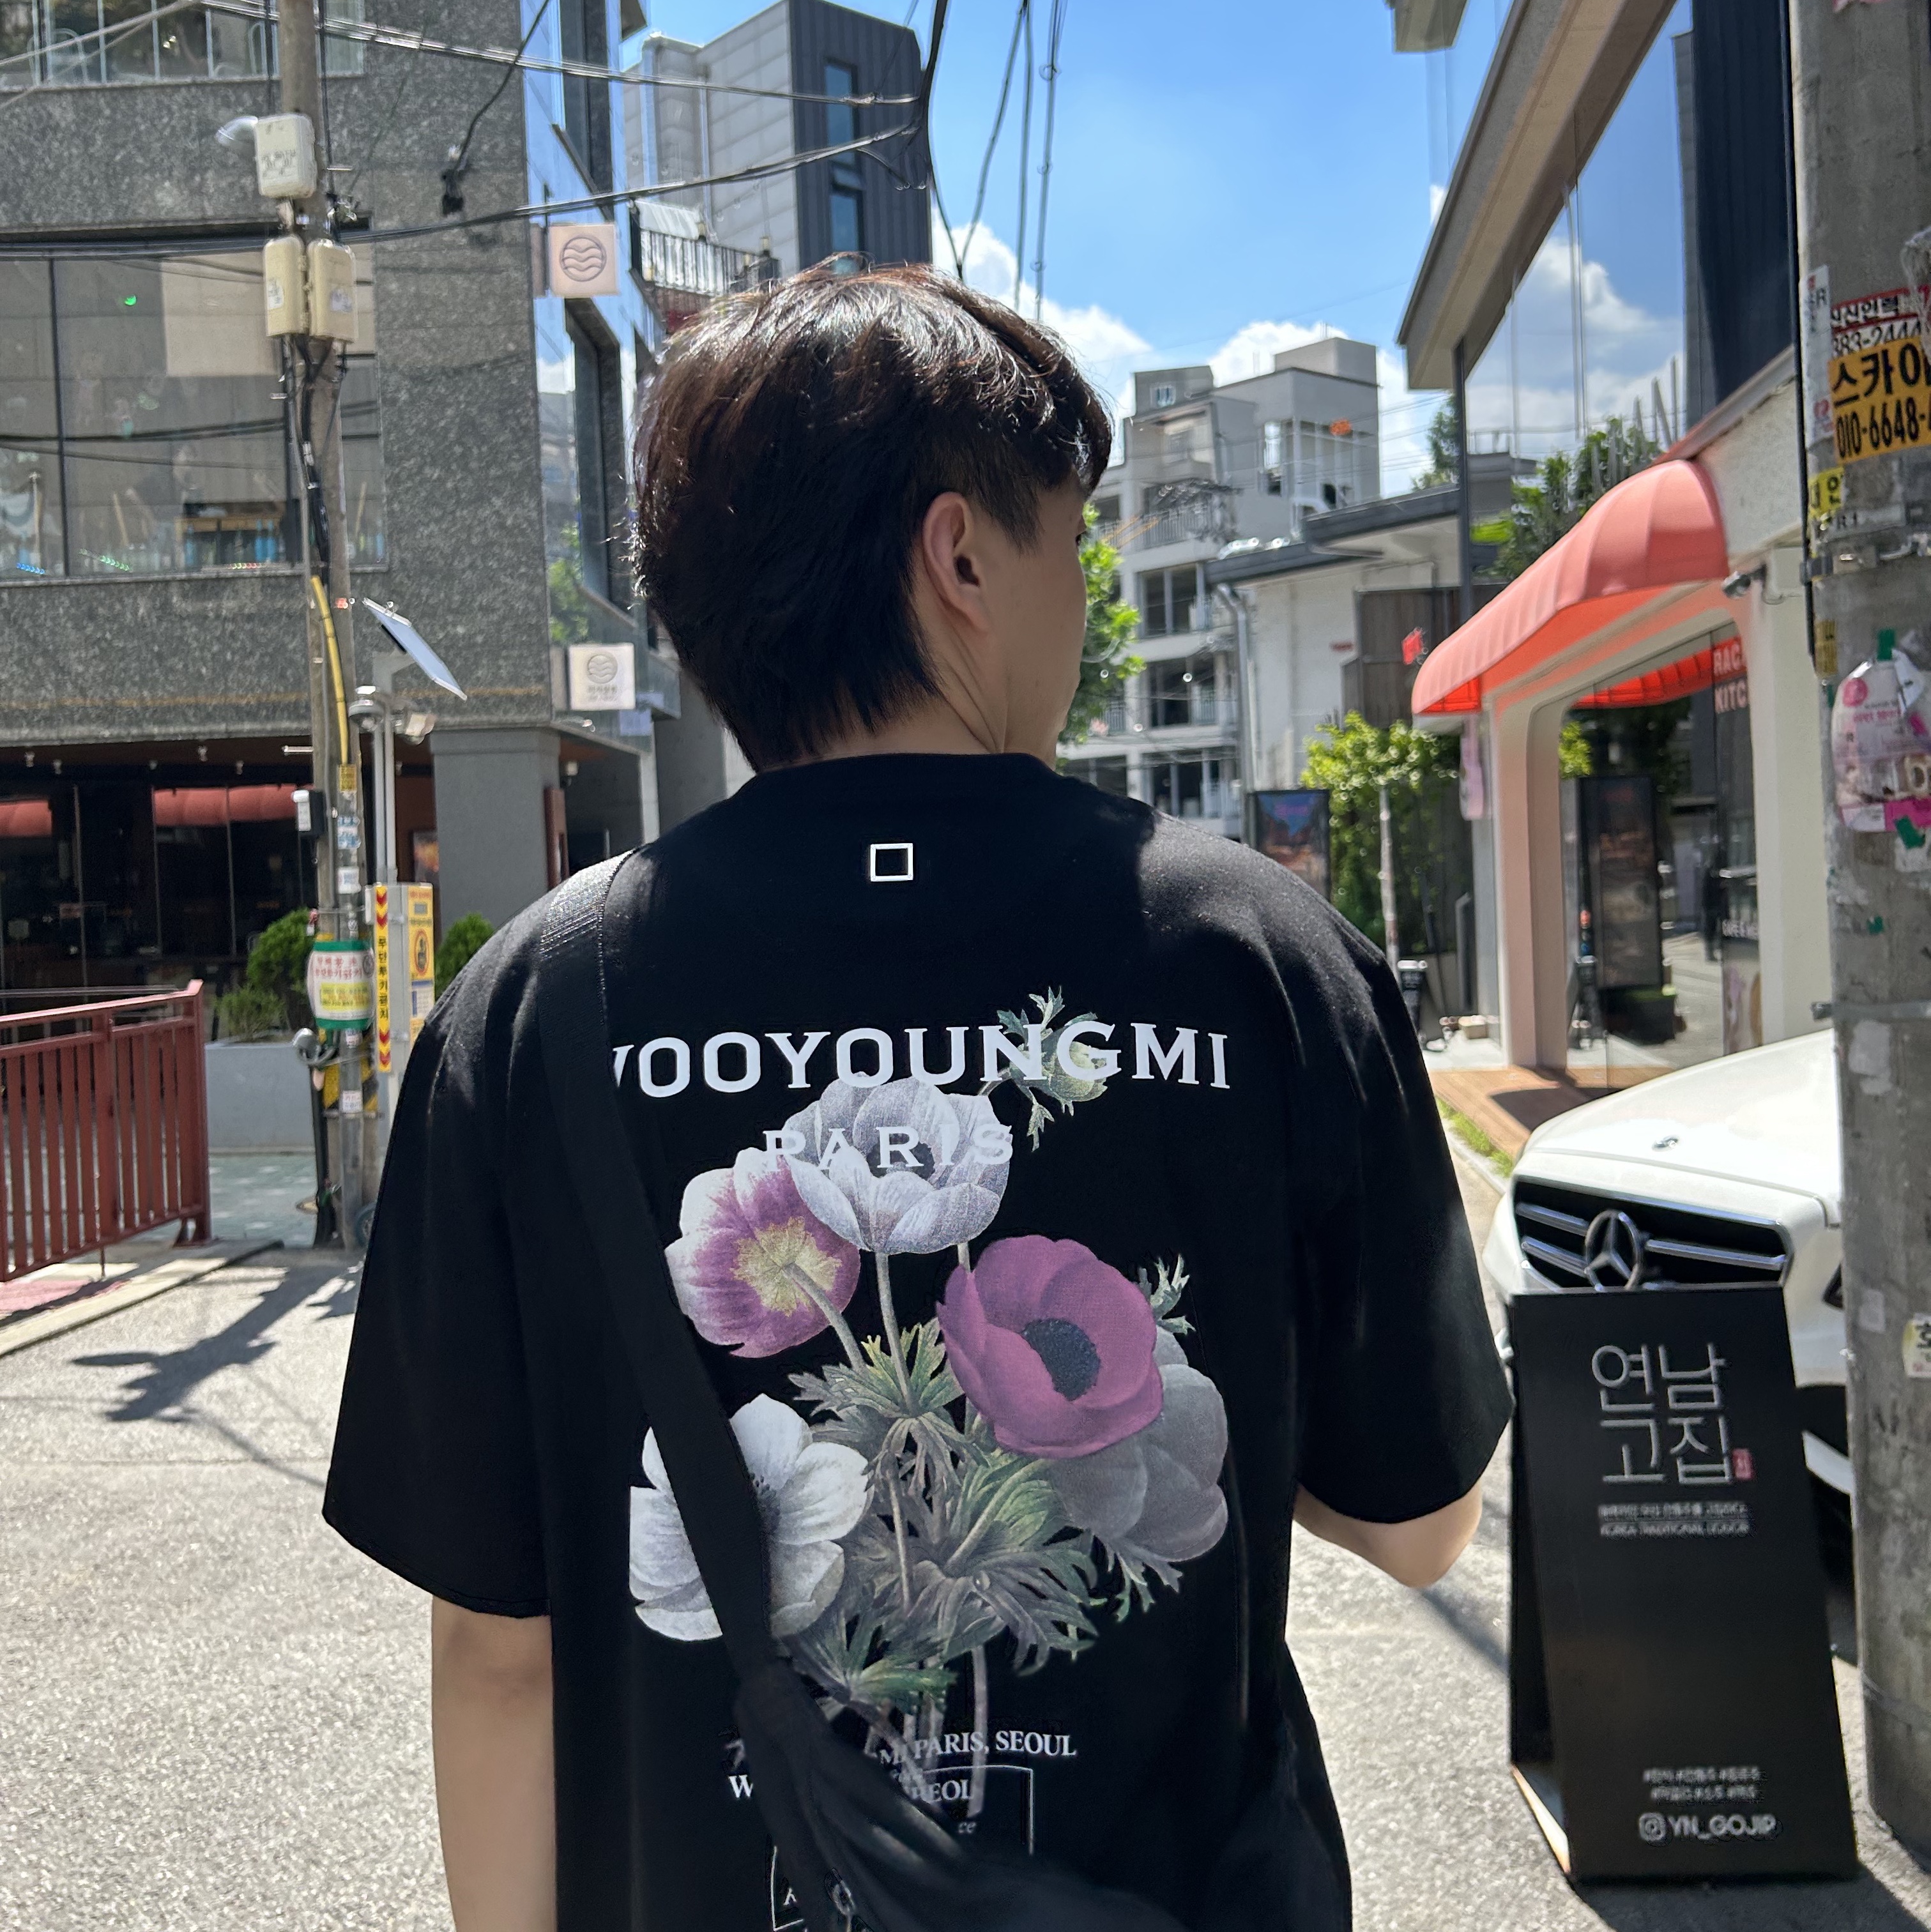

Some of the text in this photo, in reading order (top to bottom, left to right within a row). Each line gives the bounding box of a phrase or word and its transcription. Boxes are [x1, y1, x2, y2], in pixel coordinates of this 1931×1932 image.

[1836, 397, 1931, 459] 010-6648-
[763, 1123, 1014, 1173] PARIS
[1592, 1343, 1727, 1410] 연남
[1601, 1416, 1732, 1484] 고집
[996, 1730, 1077, 1756] SEOUL
